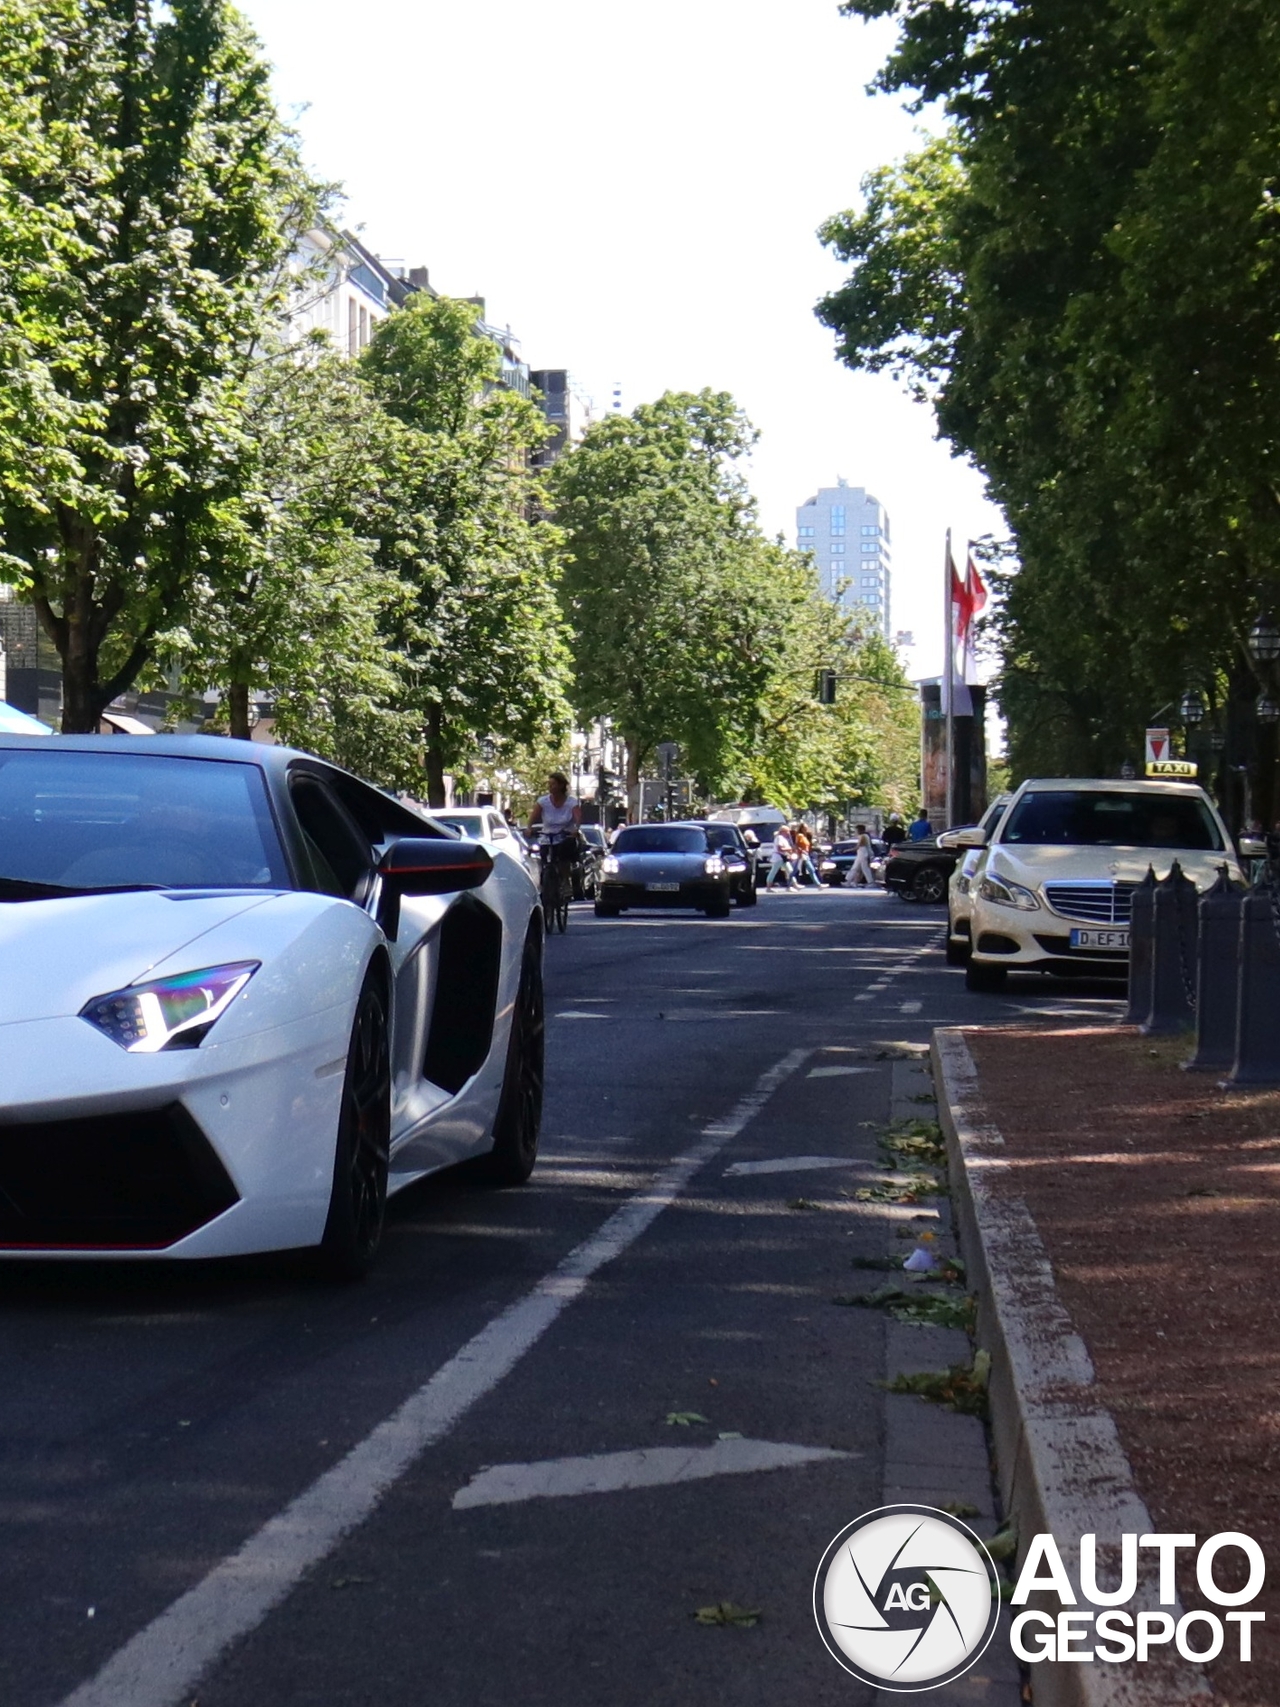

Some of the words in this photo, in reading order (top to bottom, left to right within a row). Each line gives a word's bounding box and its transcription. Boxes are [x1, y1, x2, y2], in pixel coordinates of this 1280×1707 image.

[1155, 763, 1188, 773] TAXI
[1080, 931, 1089, 945] D
[1097, 932, 1115, 946] EF
